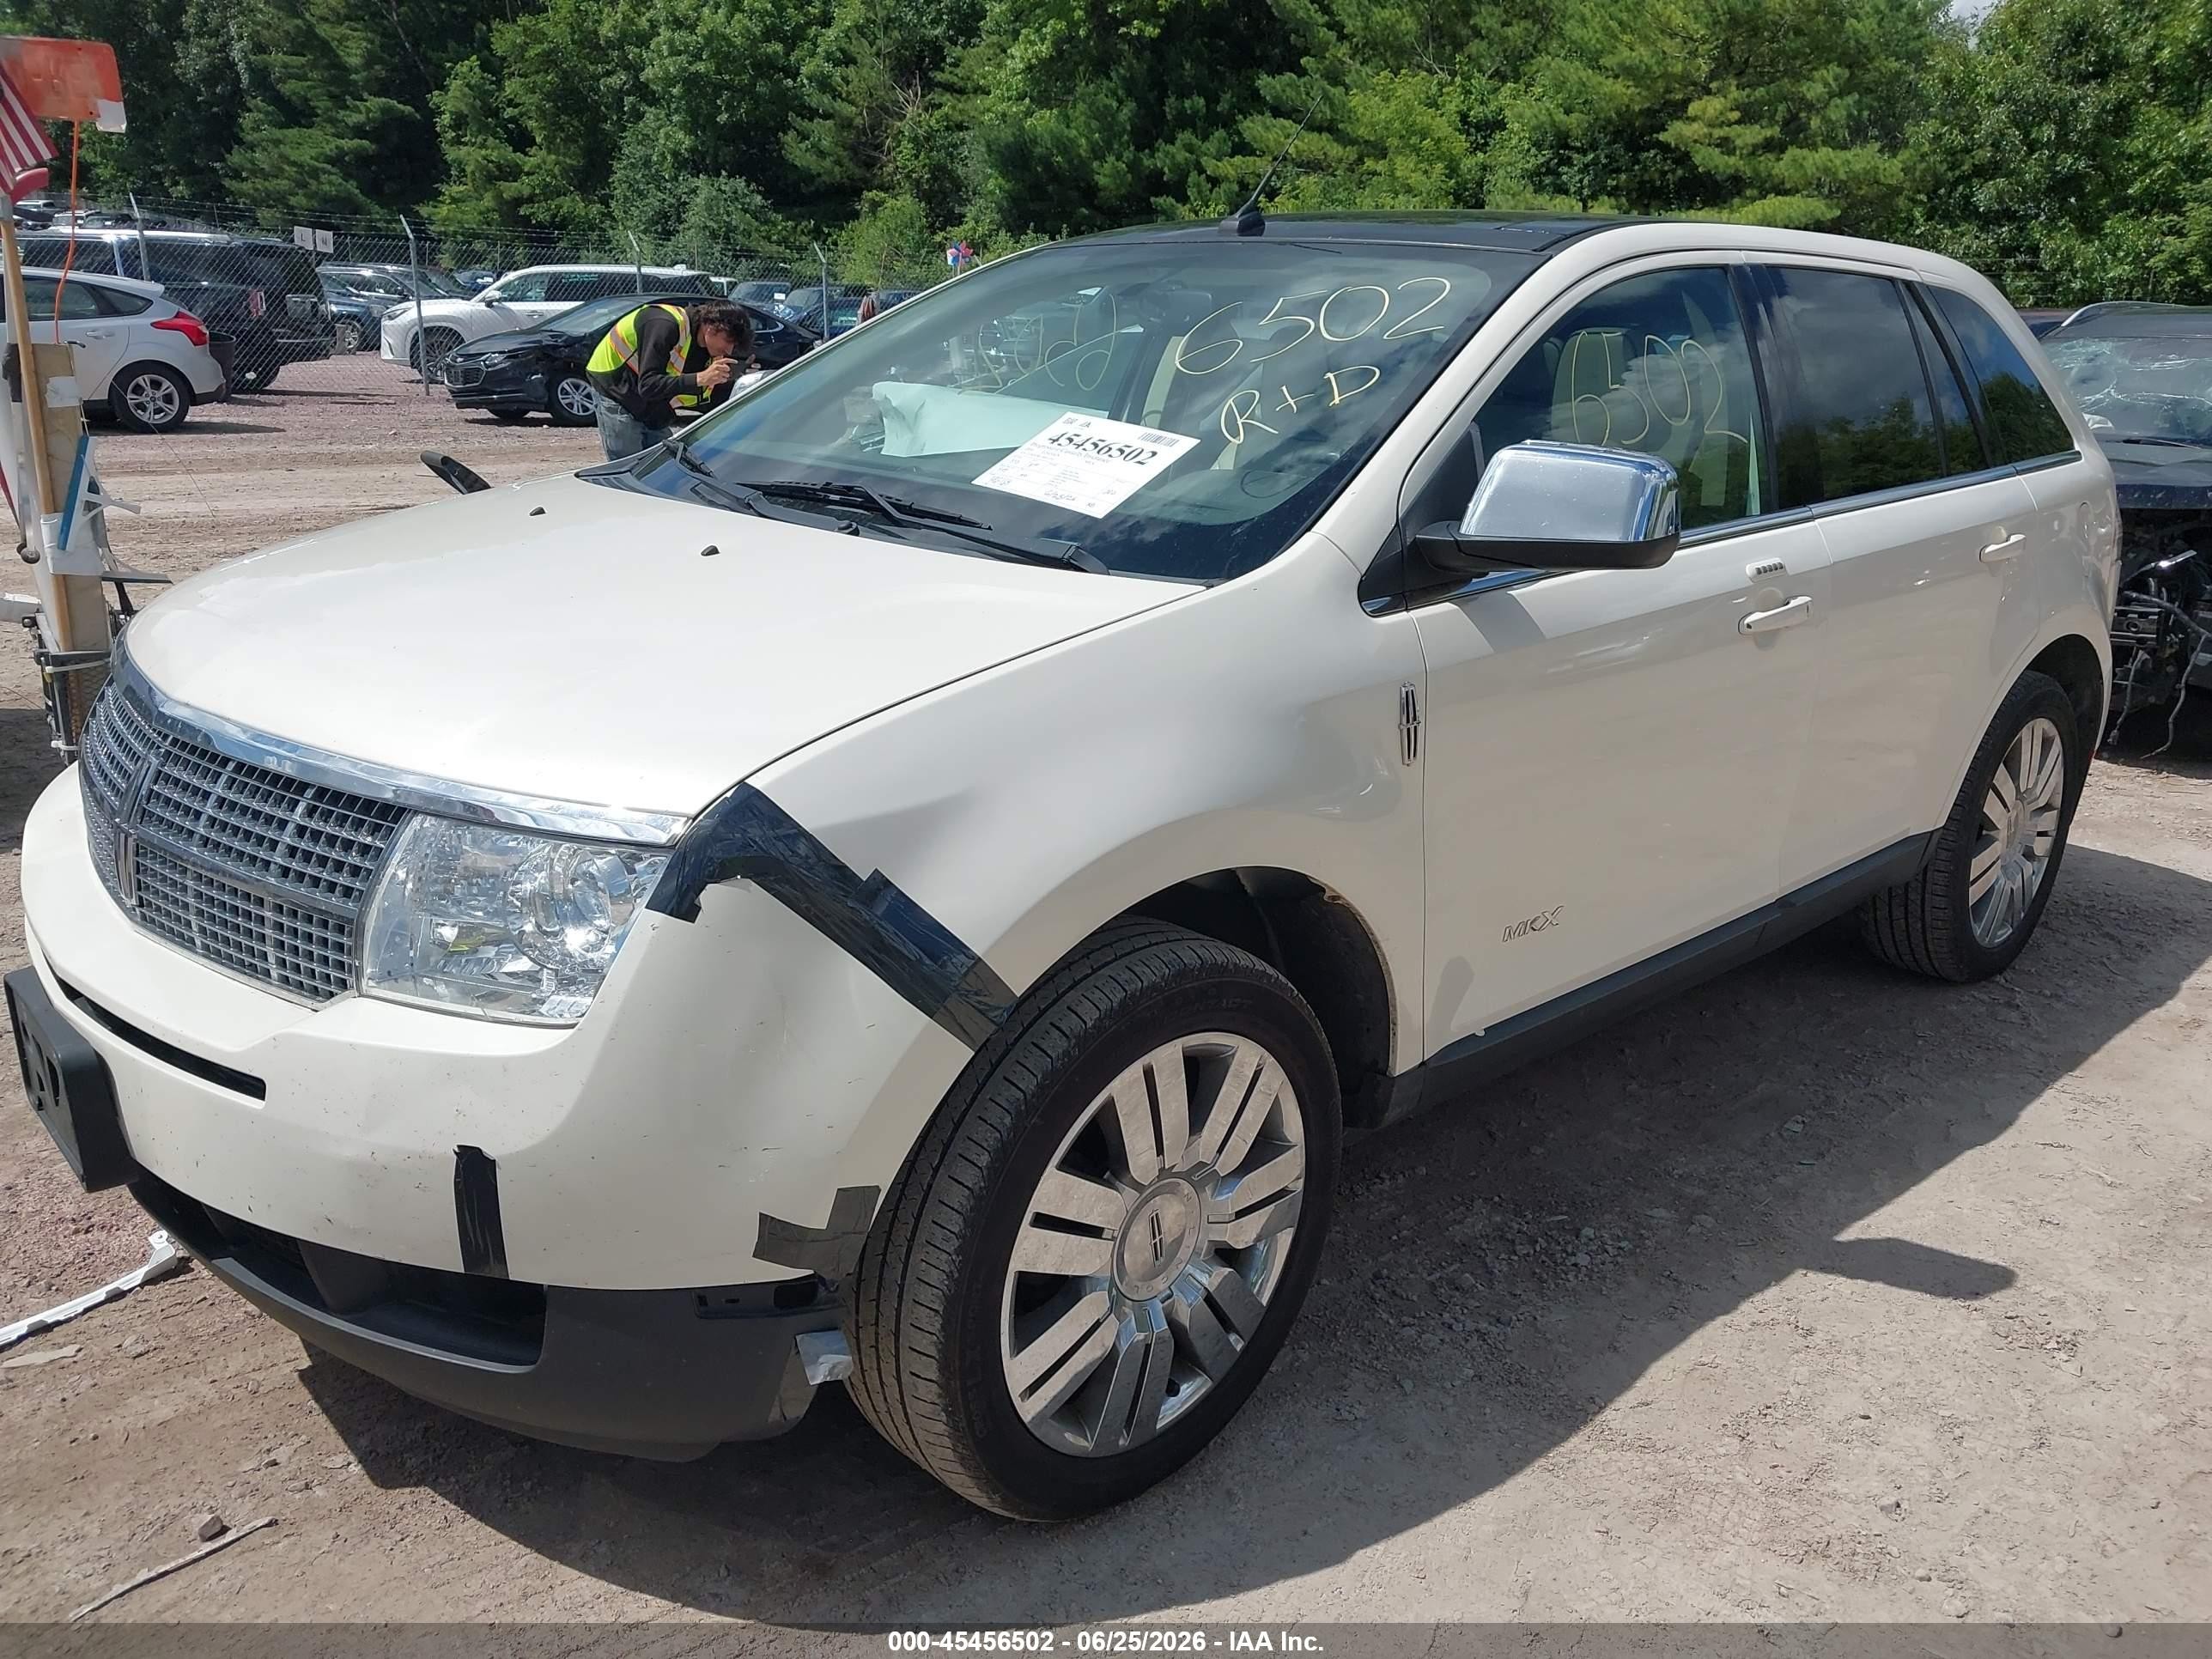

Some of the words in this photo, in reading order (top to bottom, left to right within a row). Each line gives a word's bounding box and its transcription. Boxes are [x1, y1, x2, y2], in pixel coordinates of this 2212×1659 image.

[1174, 276, 1452, 375] 6502
[1571, 331, 1748, 445] 6502
[1047, 432, 1158, 465] 45456502
[1502, 904, 1565, 943] MKX
